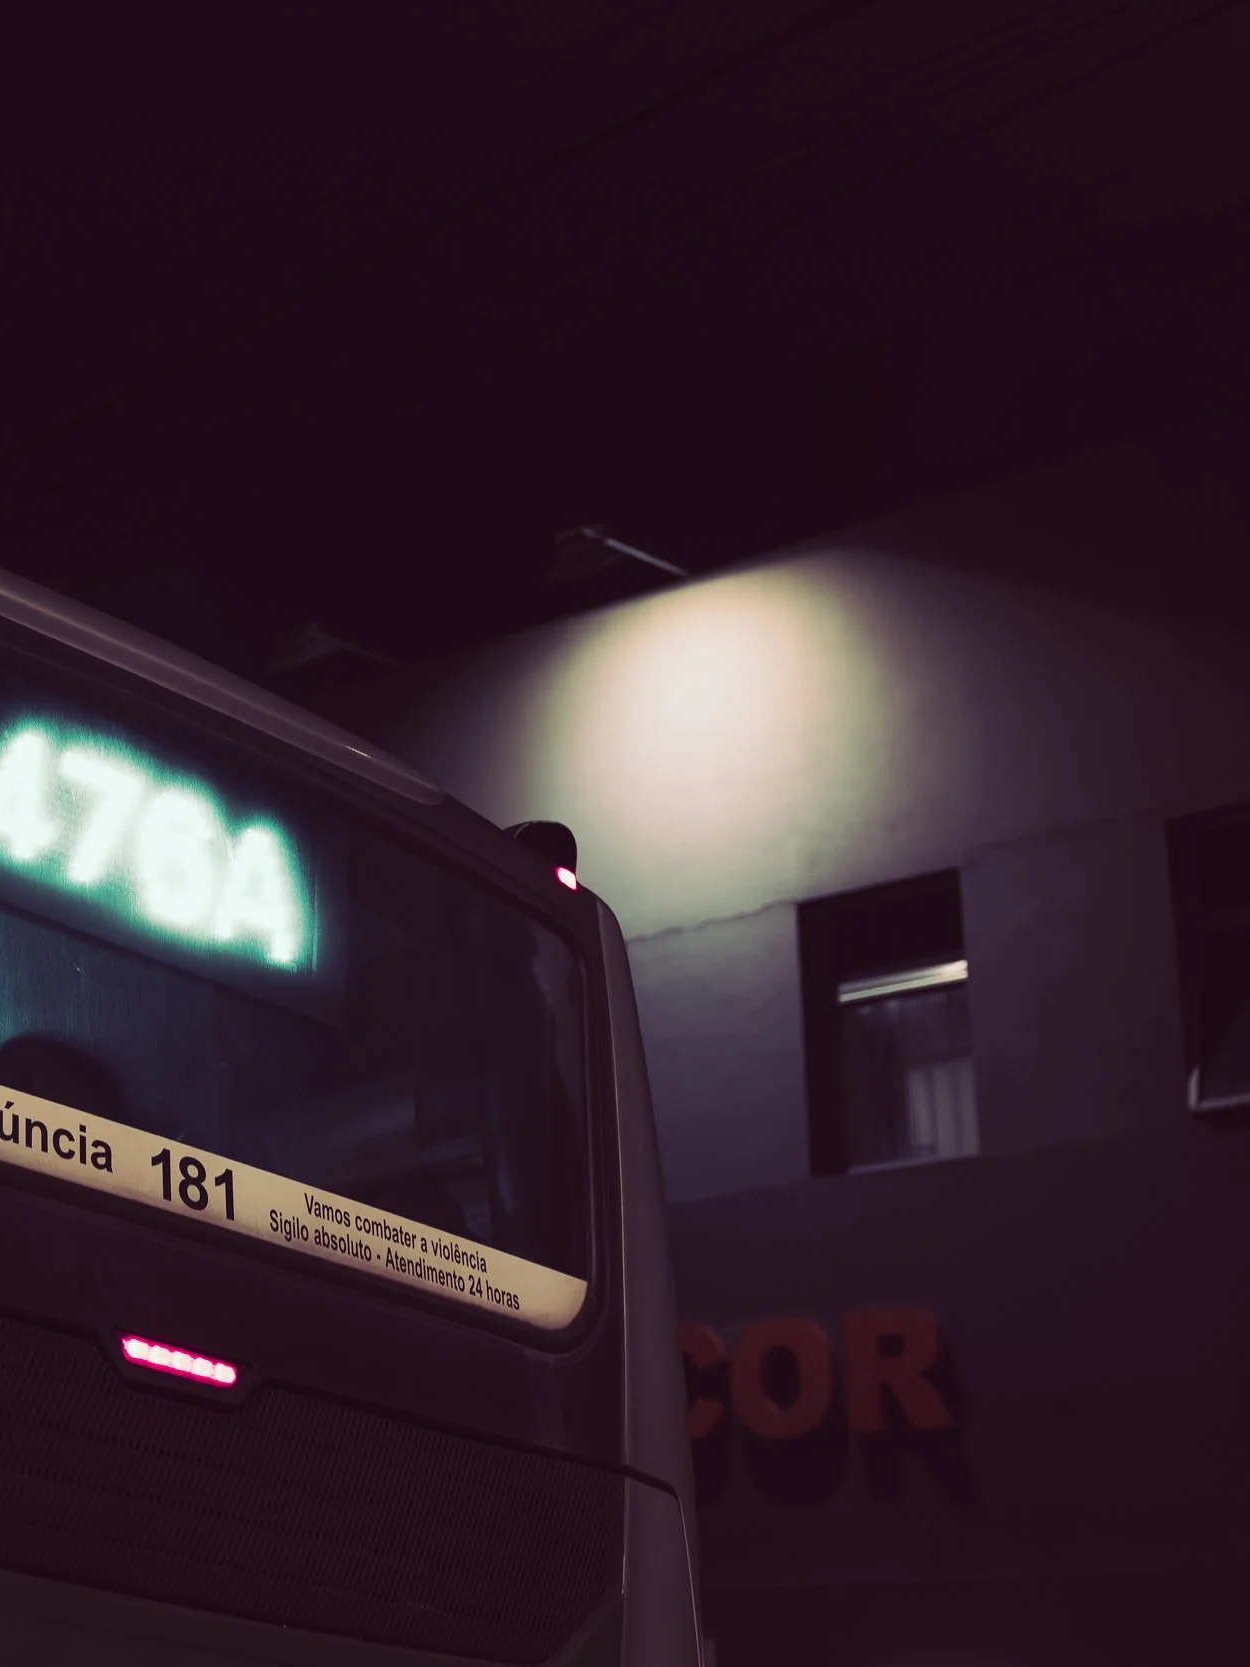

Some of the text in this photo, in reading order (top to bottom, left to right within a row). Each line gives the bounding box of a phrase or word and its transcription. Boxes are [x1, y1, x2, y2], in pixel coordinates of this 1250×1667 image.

[150, 1147, 236, 1222] 181
[268, 1209, 309, 1243] Sigilo
[313, 1228, 373, 1262] absoluto
[384, 1247, 466, 1293] Atendimento
[468, 1274, 484, 1299] 24
[485, 1283, 521, 1311] horas
[303, 1192, 488, 1274] Vamos combater a violência
